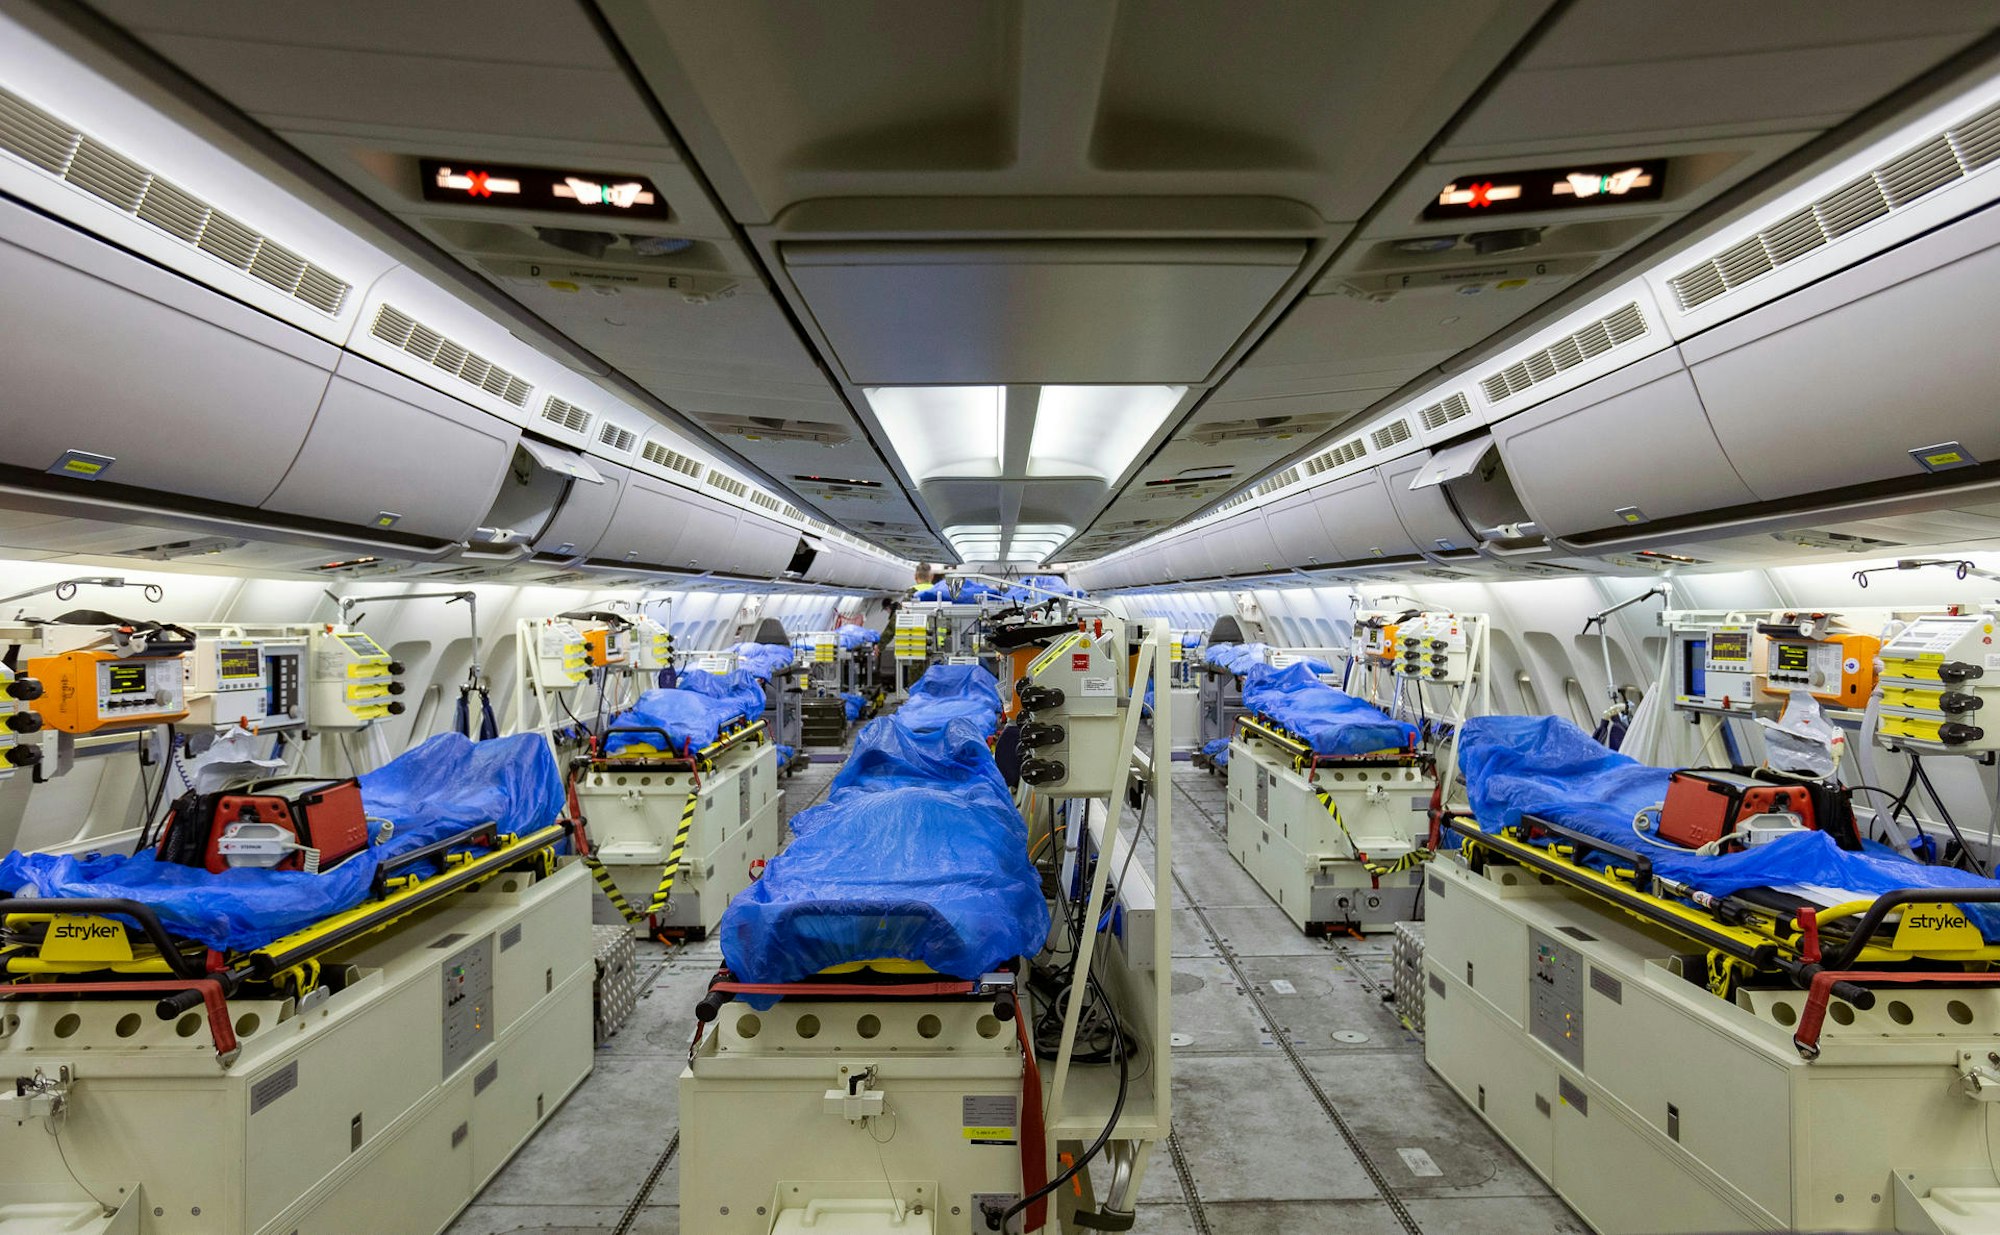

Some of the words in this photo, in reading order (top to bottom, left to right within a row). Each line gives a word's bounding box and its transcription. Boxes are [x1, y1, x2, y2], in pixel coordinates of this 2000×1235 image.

[530, 266, 541, 277] D
[1536, 263, 1546, 275] G
[668, 277, 677, 289] E
[1402, 275, 1410, 288] F
[1908, 914, 1969, 931] stryker
[55, 923, 119, 940] stryker
